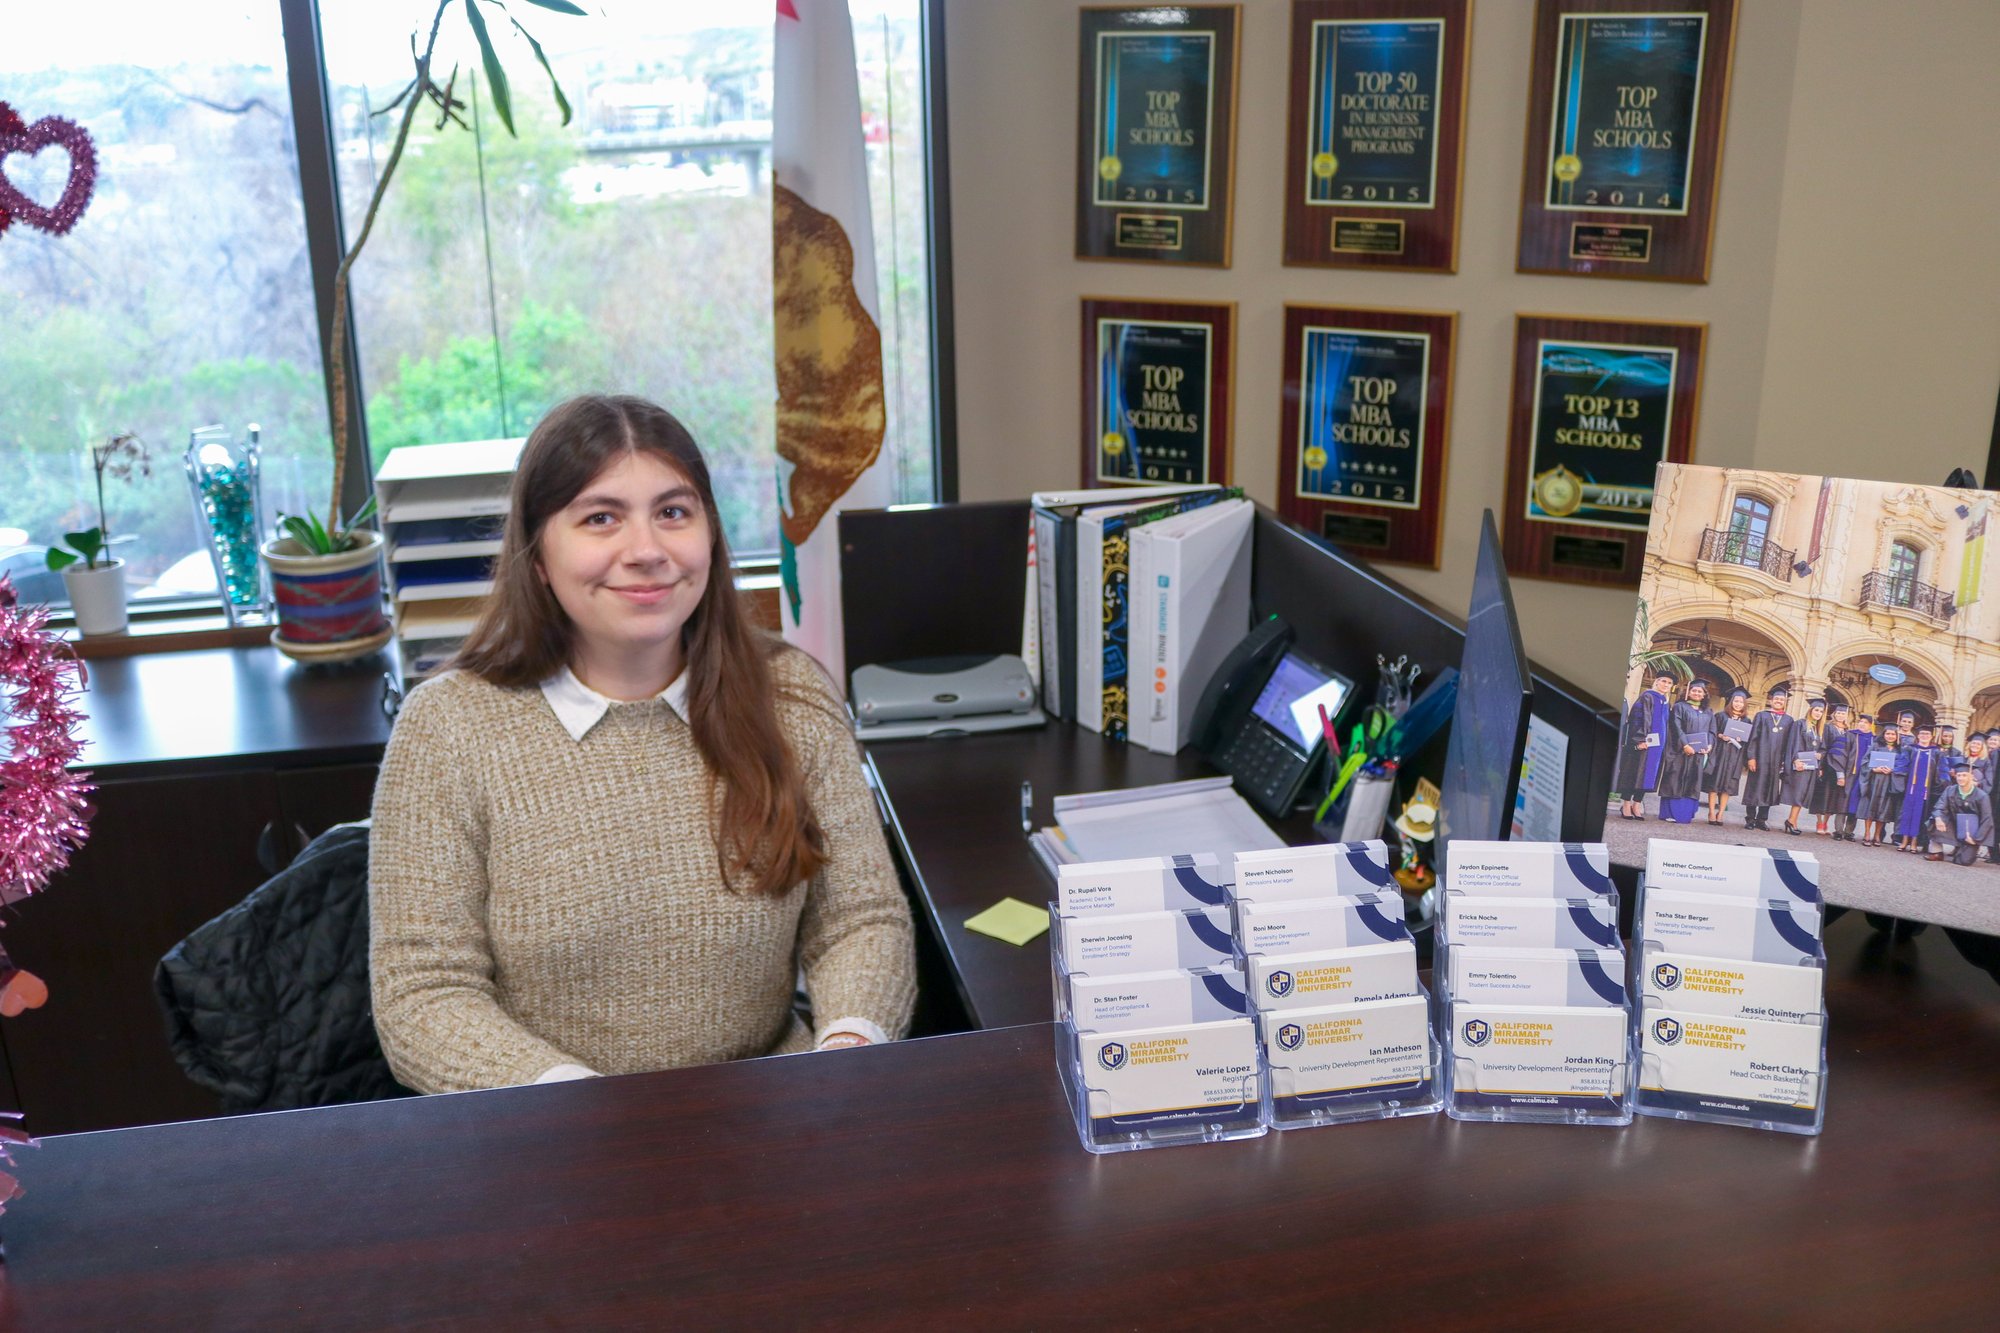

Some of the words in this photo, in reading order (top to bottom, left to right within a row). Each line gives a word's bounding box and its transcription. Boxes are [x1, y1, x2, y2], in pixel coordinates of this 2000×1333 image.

[1356, 72, 1394, 93] TOP
[1398, 72, 1417, 92] 50
[1146, 91, 1180, 111] TOP
[1341, 95, 1429, 111] DOCTORATE
[1617, 86, 1658, 109] TOP
[1145, 112, 1179, 128] MBA
[1350, 112, 1363, 124] IN
[1366, 112, 1419, 125] BUSINESS
[1615, 110, 1654, 128] MBA
[1129, 129, 1194, 146] SCHOOLS
[1342, 126, 1425, 140] MANAGEMENT
[1593, 130, 1672, 149] SCHOOLS
[1351, 141, 1414, 154] PROGRAMS
[1141, 365, 1184, 391] TOP
[1349, 376, 1397, 405] TOP
[1143, 391, 1180, 412] MBA
[1564, 394, 1611, 415] TOP
[1616, 399, 1640, 418] 13
[1127, 410, 1197, 433] SCHOOLS
[1351, 405, 1392, 427] MBA
[1579, 415, 1620, 433] MBA
[1332, 424, 1410, 448] SCHOOLS
[1555, 428, 1642, 450] SCHOOLS
[1597, 490, 1643, 509] 2013
[1078, 887, 1096, 895] Rupali
[1093, 902, 1115, 910] Manager
[1654, 921, 1679, 929] University
[1106, 934, 1132, 942] Jocosing
[1254, 934, 1278, 942] University
[1279, 931, 1310, 939] Development
[1654, 928, 1692, 936] Representative
[1254, 940, 1289, 948] Representative
[1296, 966, 1352, 977] CALIFORNIA
[1685, 968, 1744, 980] CALIFORNIA
[1297, 975, 1340, 985] MIRAMAR
[1684, 976, 1731, 986] MIRAMAR
[1298, 981, 1352, 992] UNIVERSITY
[1684, 983, 1744, 995] UNIVERSITY
[1354, 994, 1382, 1003] Pamela
[1384, 992, 1410, 1000] Adams
[1116, 1003, 1145, 1012] Compliance
[1741, 1005, 1766, 1015] Jessie
[1306, 1019, 1362, 1030] CALIFORNIA
[1686, 1023, 1746, 1035] CALIFORNIA
[1307, 1027, 1351, 1038] MIRAMAR
[1686, 1030, 1732, 1041] MIRAMAR
[1130, 1038, 1188, 1049] CALIFORNIA
[1307, 1034, 1363, 1046] UNIVERSITY
[1494, 1038, 1552, 1046] UNIVERSITY
[1685, 1038, 1746, 1050] UNIVERSITY
[1130, 1047, 1176, 1057] MIRAMAR
[1369, 1048, 1382, 1056] Ian
[1384, 1044, 1422, 1054] Matheson
[1131, 1053, 1189, 1065] UNIVERSITY
[1299, 1064, 1330, 1072] University
[1332, 1059, 1375, 1069] Development
[1376, 1053, 1422, 1064] Representative
[1564, 1056, 1593, 1064] Jordan
[1595, 1057, 1614, 1066] King
[1196, 1067, 1224, 1076] Valerie
[1226, 1065, 1250, 1075] Lopez
[1483, 1064, 1516, 1072] University
[1518, 1065, 1563, 1073] Development
[1565, 1066, 1612, 1074] Representativ
[1750, 1062, 1780, 1072] Robert
[1782, 1066, 1809, 1075] Clarke
[1730, 1070, 1749, 1078] Head
[1750, 1072, 1772, 1081] Coach
[1511, 1096, 1558, 1104] www.calmu.edu
[1700, 1100, 1749, 1111] www.calmu.edu
